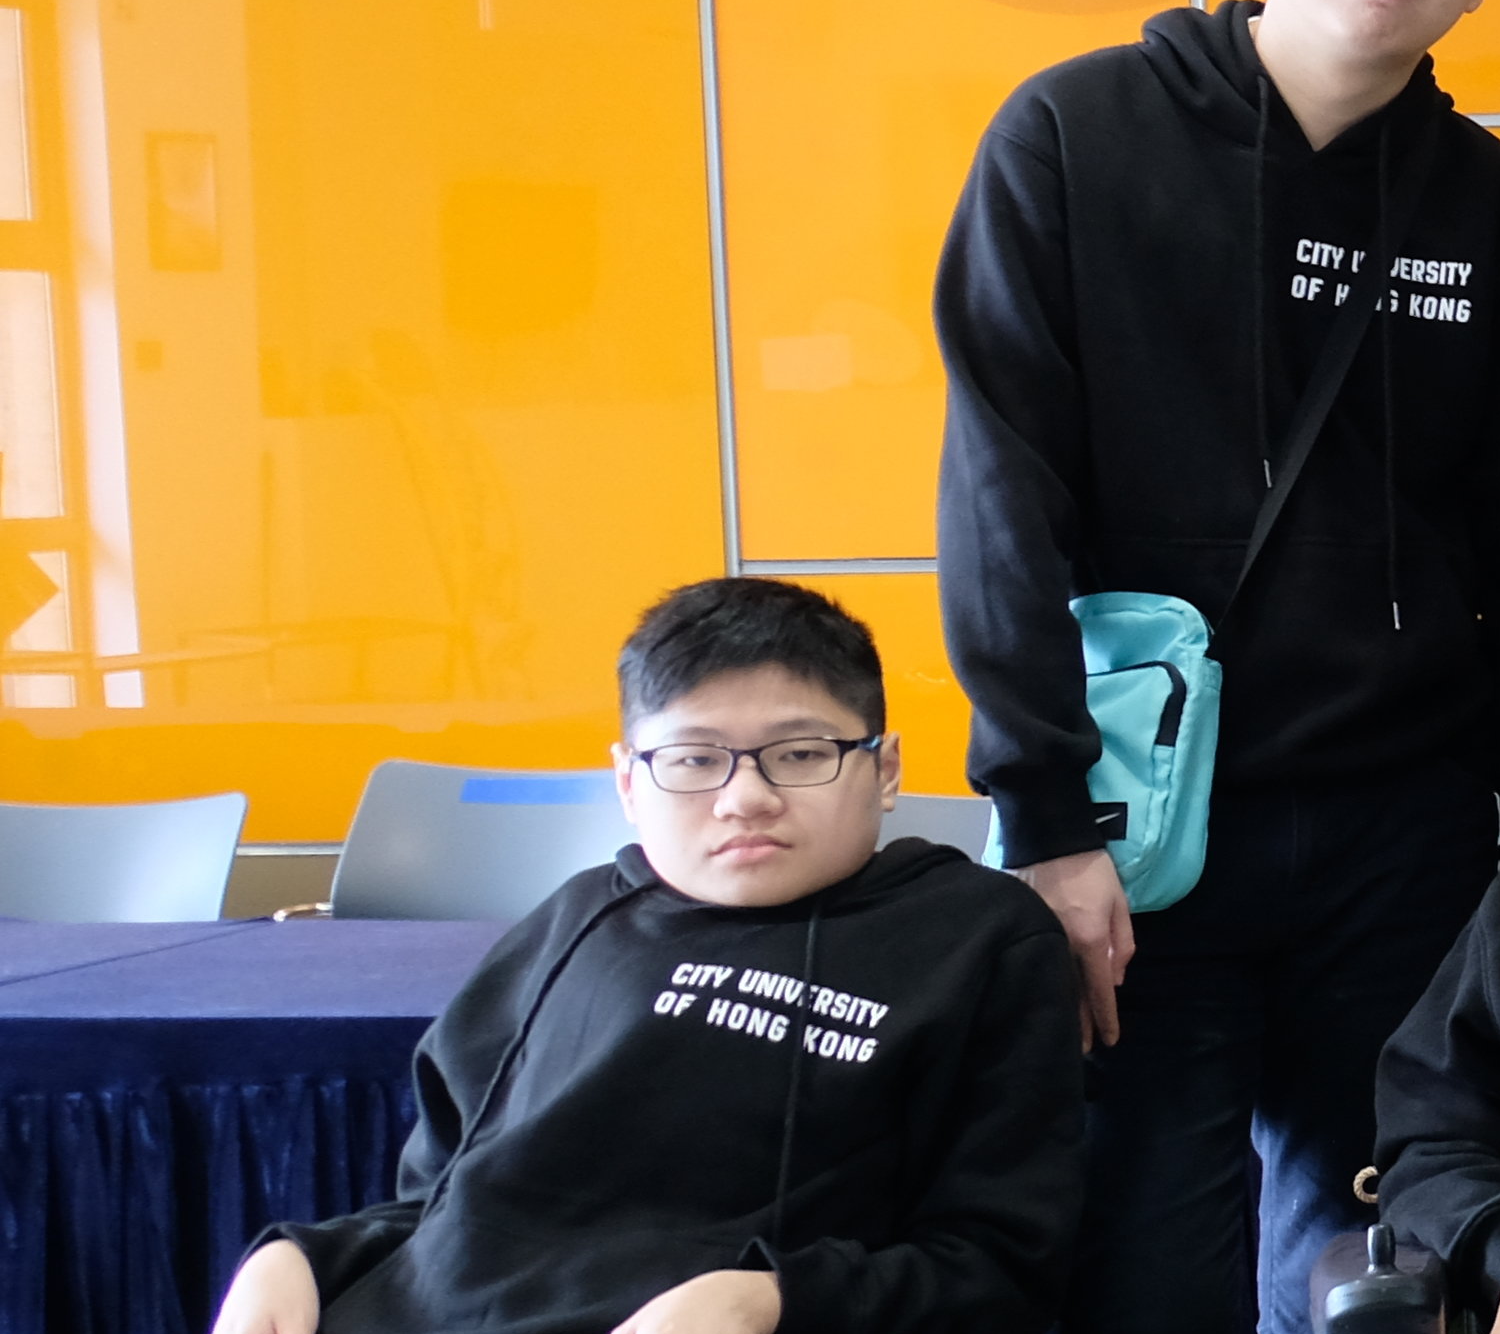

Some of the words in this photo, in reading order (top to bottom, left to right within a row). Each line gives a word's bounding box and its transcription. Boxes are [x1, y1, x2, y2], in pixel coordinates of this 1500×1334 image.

[1296, 238, 1345, 270] CITY
[1351, 249, 1473, 287] UERSITY
[1290, 274, 1324, 302] OF
[1408, 293, 1473, 324] KONG
[671, 962, 734, 989] CITY
[738, 968, 891, 1029] UNIVERSITY
[653, 990, 699, 1017] OF
[705, 997, 792, 1043] HONG
[802, 1023, 880, 1064] KONG
